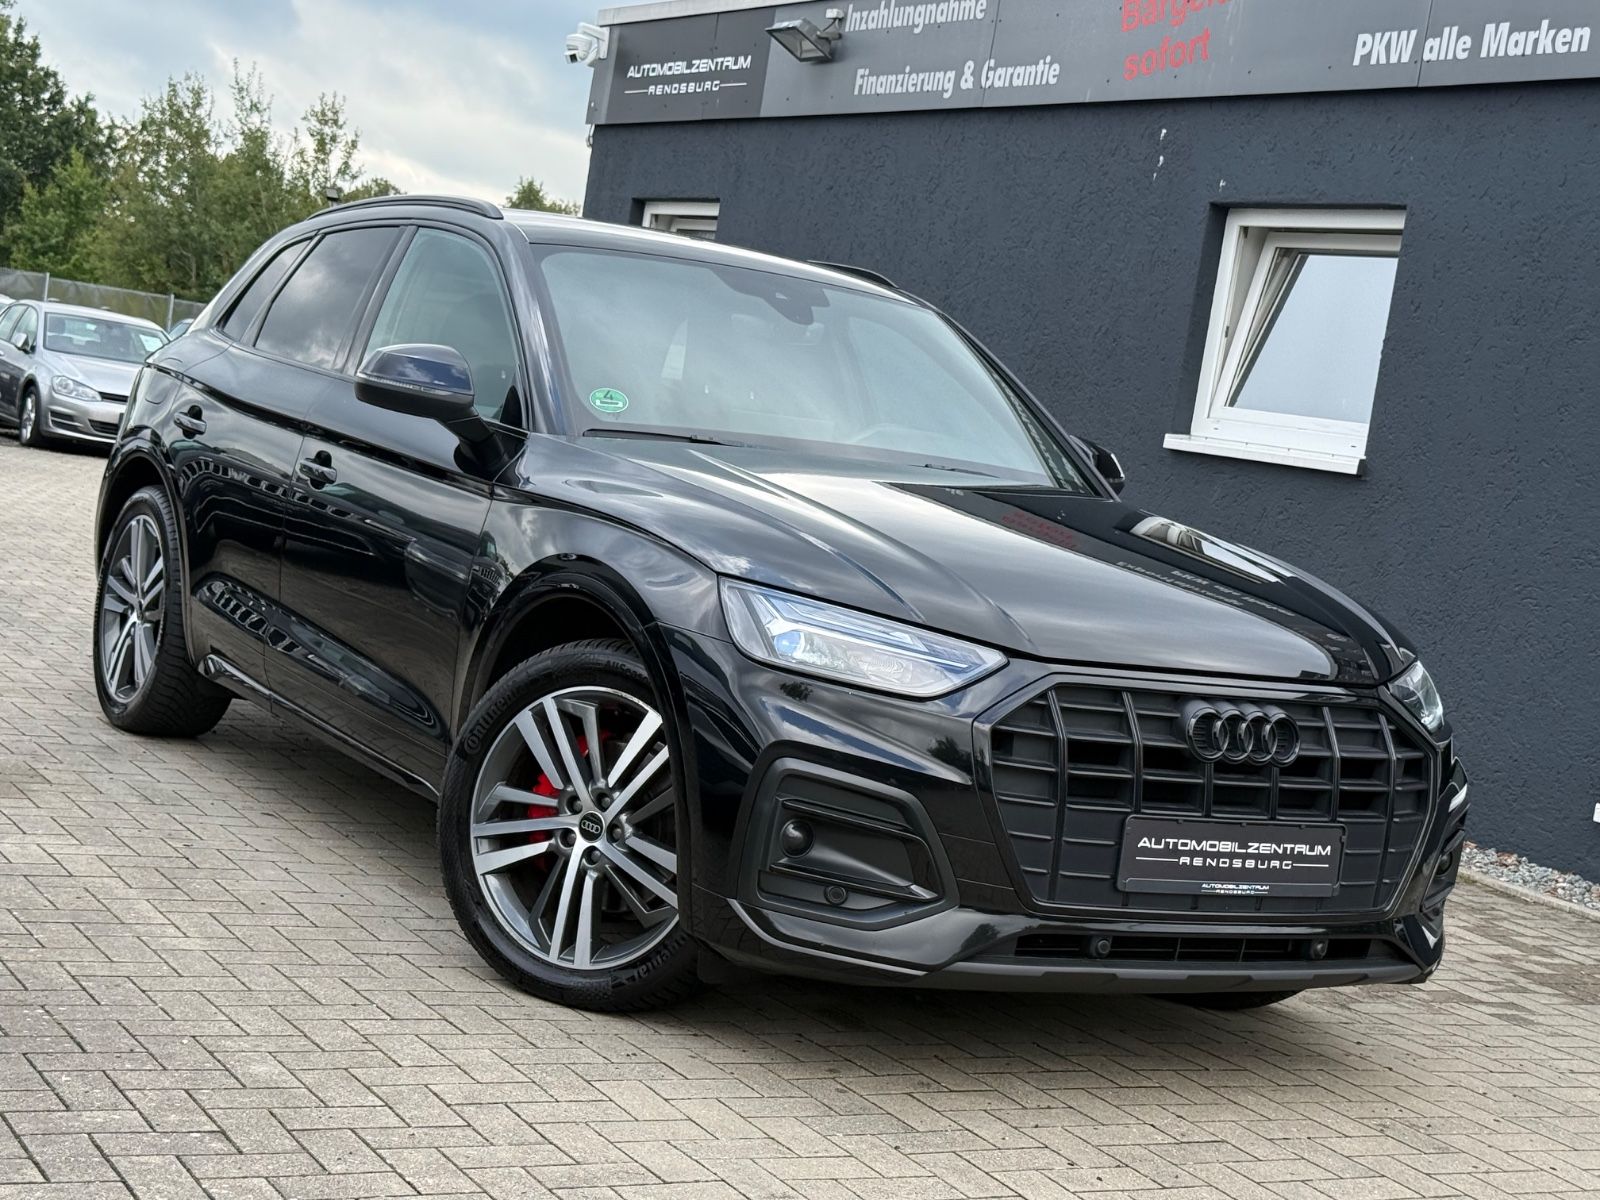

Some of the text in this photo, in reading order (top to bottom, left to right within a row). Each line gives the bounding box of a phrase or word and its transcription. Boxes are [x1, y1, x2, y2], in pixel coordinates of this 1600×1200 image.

[844, 0, 988, 34] Inzahlungnahme
[1122, 27, 1211, 81] sofort
[1352, 19, 1591, 66] PKW alle Marken
[626, 54, 752, 79] AUTOMOBILZENTRUM
[853, 54, 1061, 99] Finanzierung & Garantie
[648, 80, 721, 95] RENDSBURG
[1137, 837, 1332, 856] AUTOMOBILZENTRUM
[1179, 856, 1293, 870] RENDSBURG
